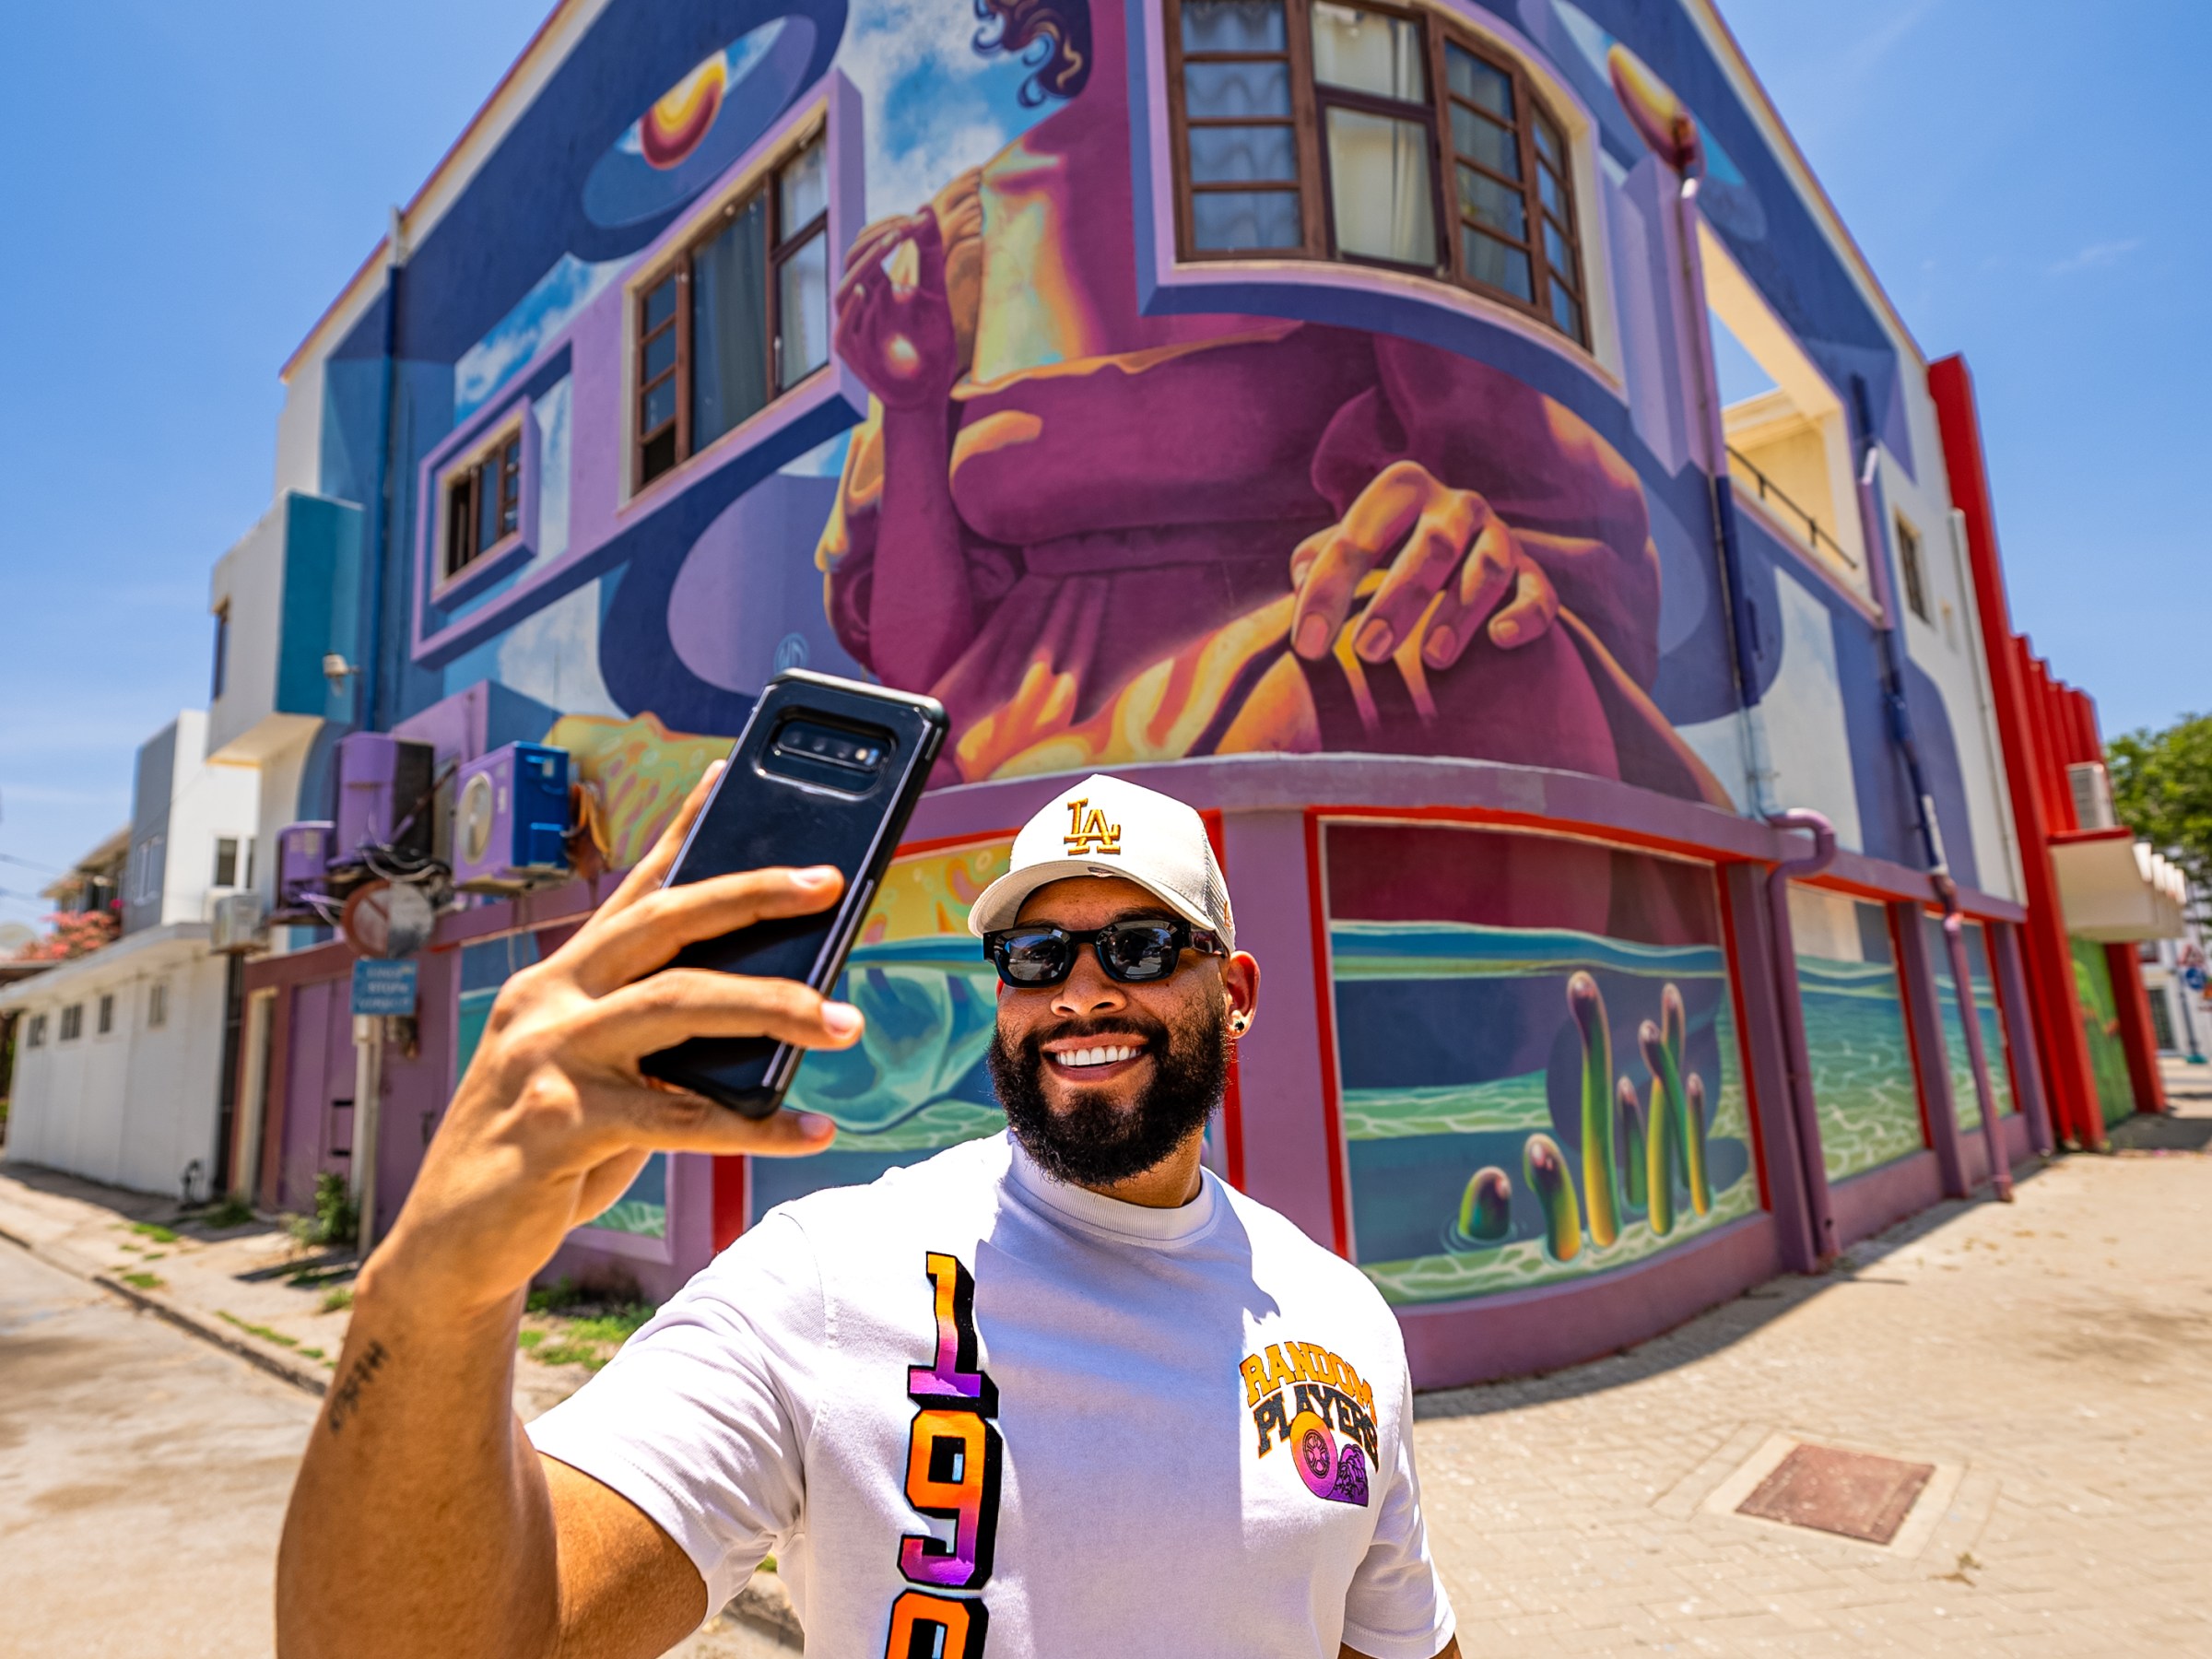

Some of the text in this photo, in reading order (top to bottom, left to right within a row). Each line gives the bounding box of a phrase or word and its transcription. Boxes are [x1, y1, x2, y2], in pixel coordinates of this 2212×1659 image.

[1064, 798, 1121, 855] LA
[1239, 1341, 1378, 1429] RANDOM
[1253, 1383, 1380, 1475] PLAYERS
